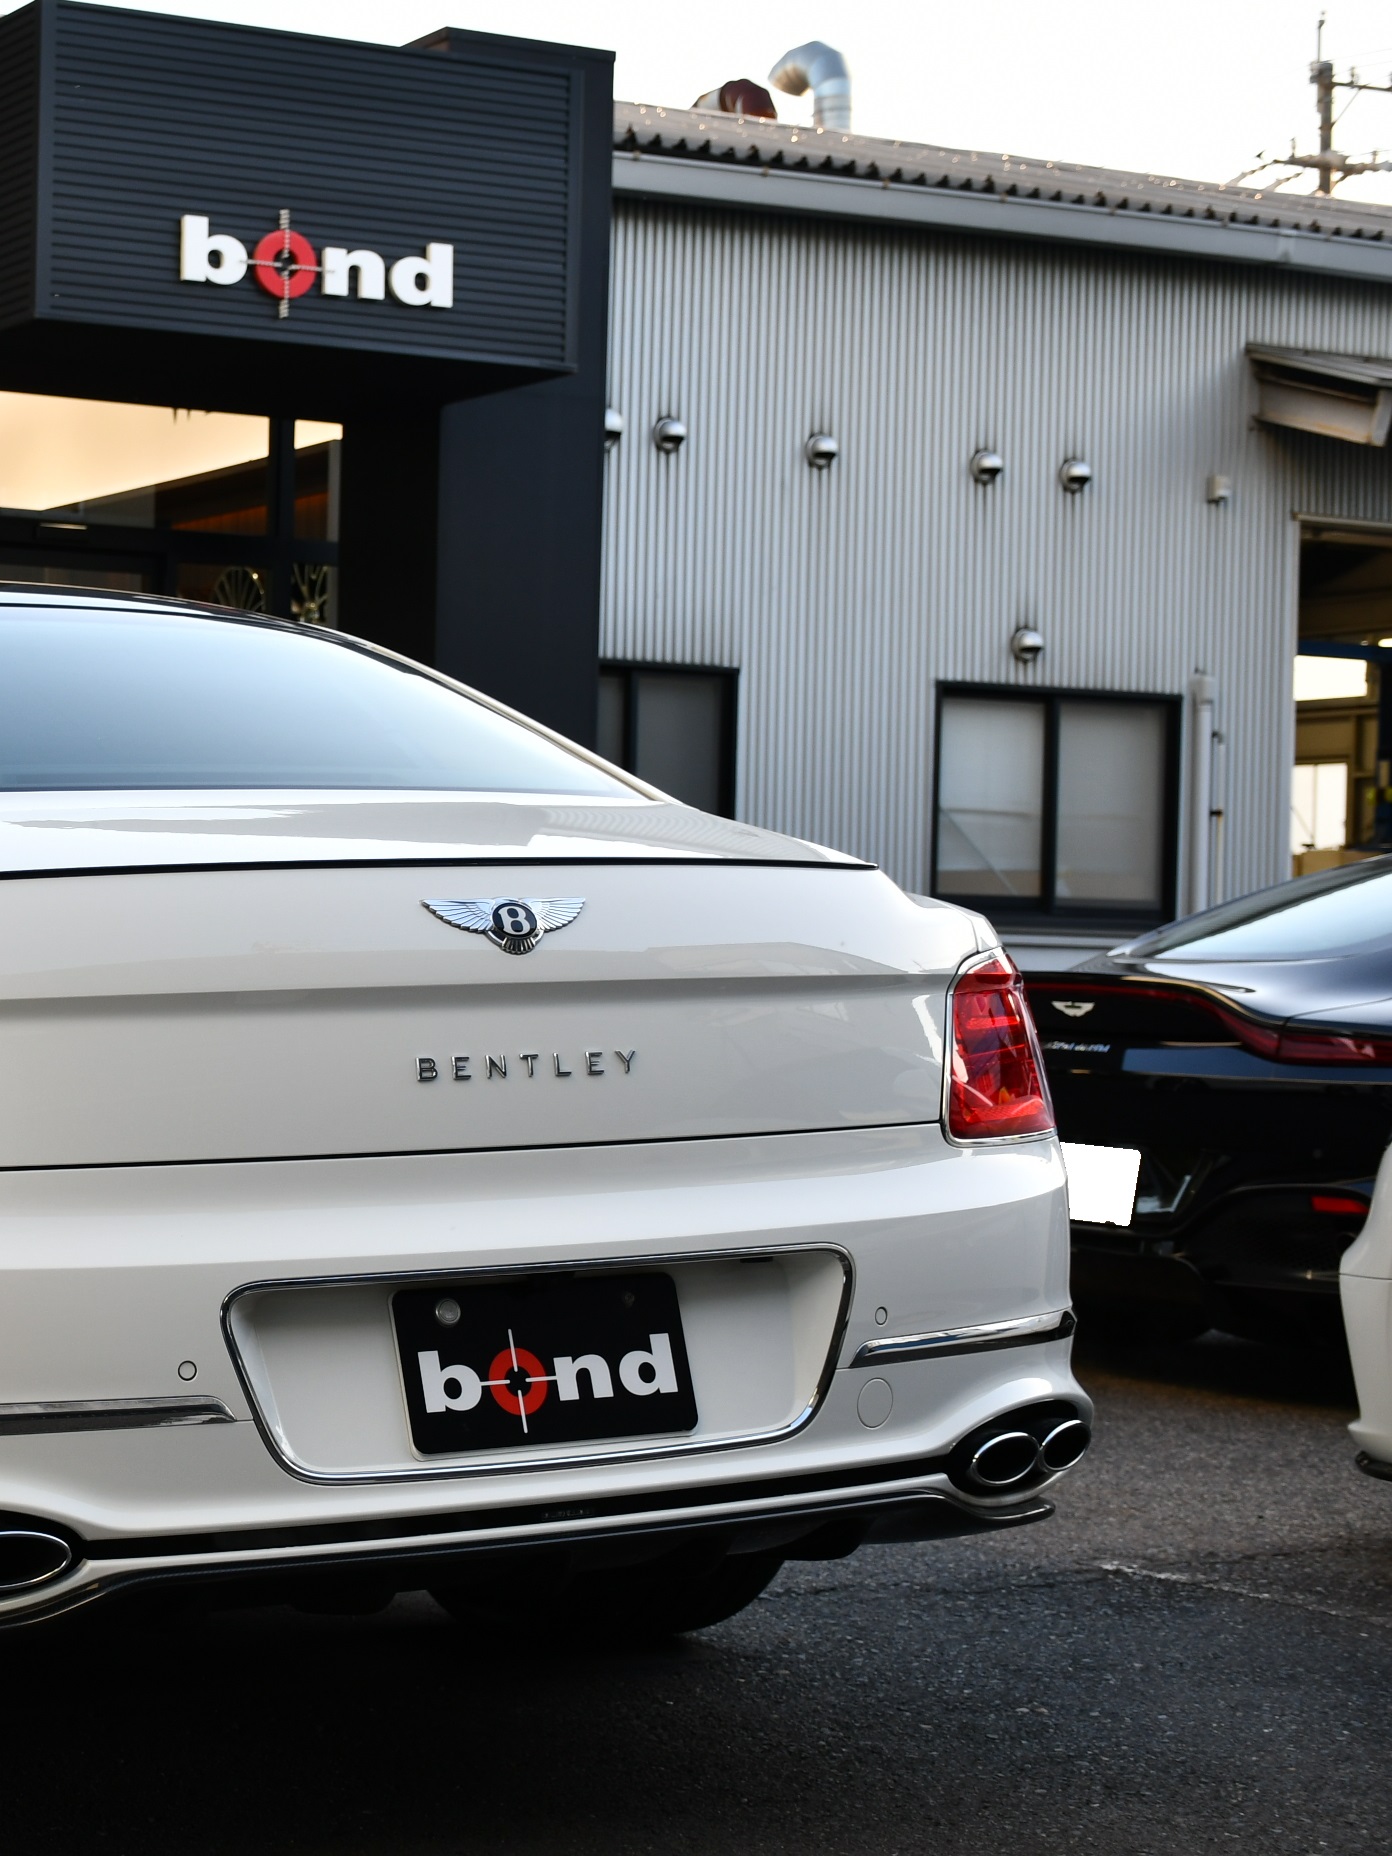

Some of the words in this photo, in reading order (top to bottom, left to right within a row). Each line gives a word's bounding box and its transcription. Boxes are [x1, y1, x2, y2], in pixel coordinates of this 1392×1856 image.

[179, 213, 454, 309] bond
[499, 905, 530, 935] B
[415, 1049, 636, 1082] BENTLEY
[417, 1332, 679, 1416] bond
